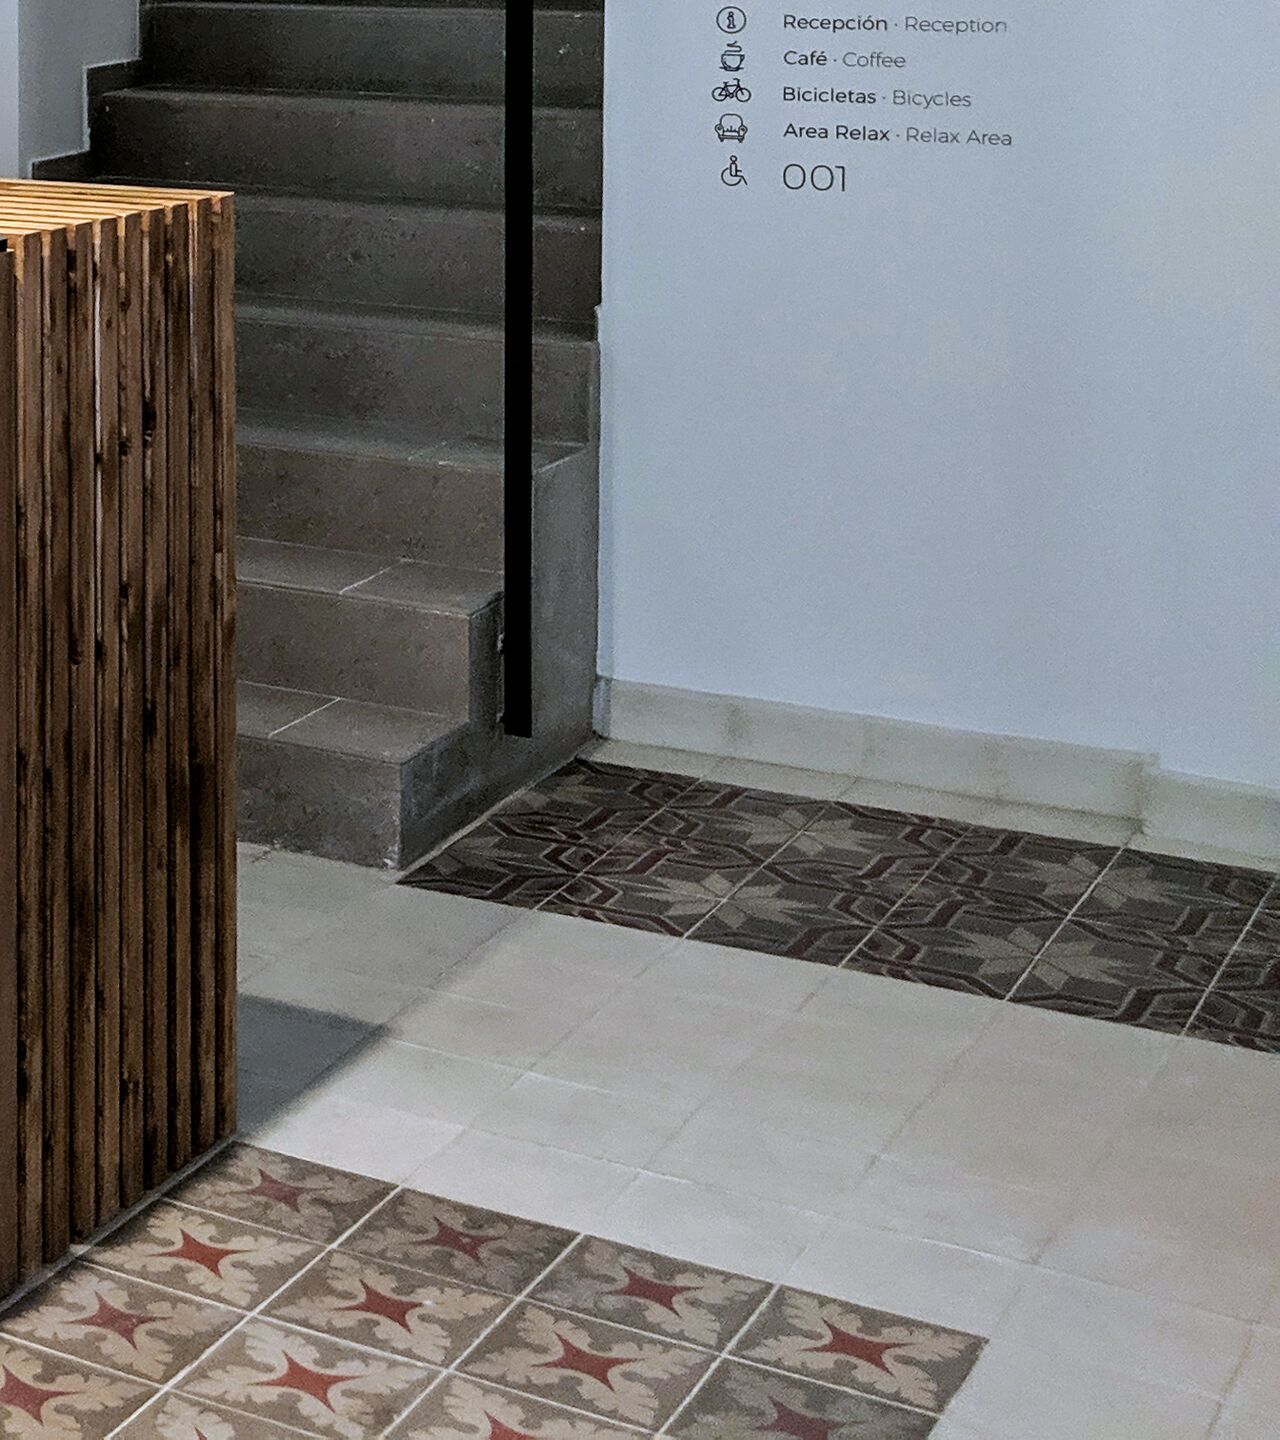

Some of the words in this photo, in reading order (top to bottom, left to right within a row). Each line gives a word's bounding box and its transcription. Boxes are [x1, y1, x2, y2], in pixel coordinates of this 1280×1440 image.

[784, 15, 887, 33] Recepción
[906, 17, 1007, 35] Reception
[784, 51, 827, 65] Café
[843, 52, 906, 68] Coffee
[784, 87, 876, 104] Bicicletas
[893, 90, 971, 109] Bicycles
[784, 124, 828, 138] Area
[836, 125, 889, 141] Relax
[907, 127, 960, 143] Relax
[967, 130, 1011, 145] Area
[783, 164, 845, 191] 001
